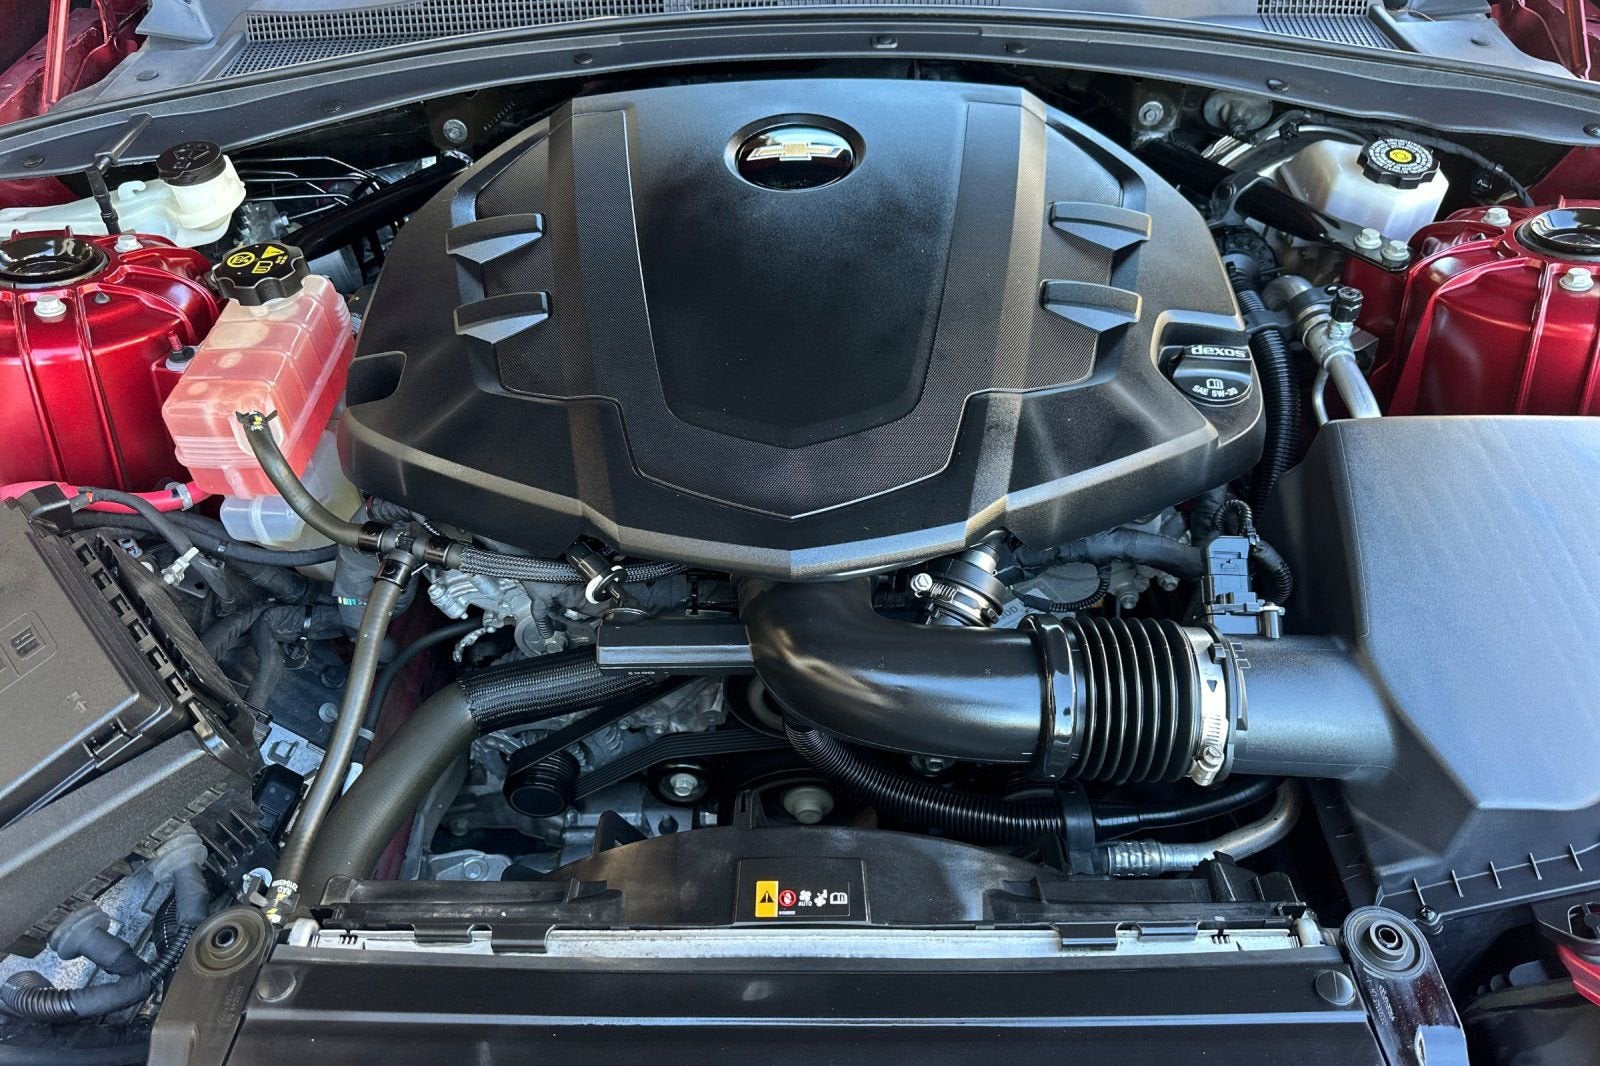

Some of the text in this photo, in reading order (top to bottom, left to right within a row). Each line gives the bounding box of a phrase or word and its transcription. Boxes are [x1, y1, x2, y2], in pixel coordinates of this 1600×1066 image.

[1191, 345, 1247, 358] dexos
[1192, 385, 1238, 398] SAE 5W-30
